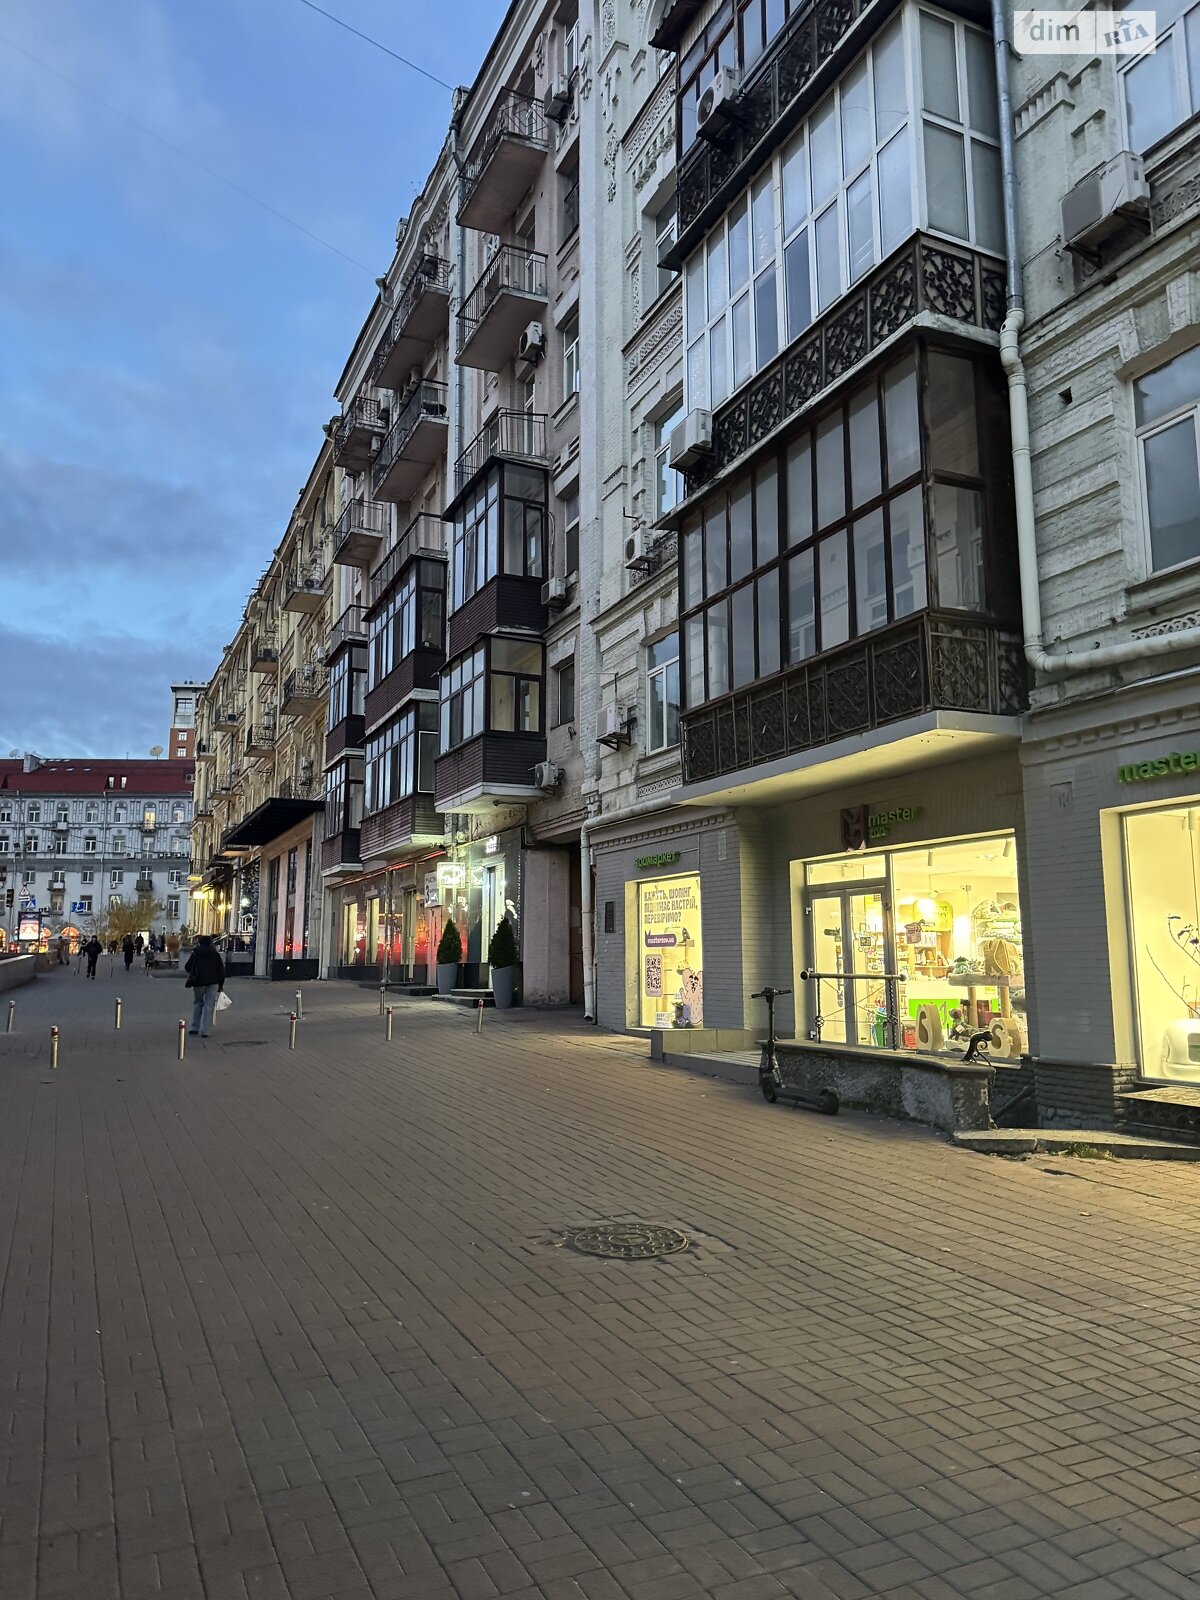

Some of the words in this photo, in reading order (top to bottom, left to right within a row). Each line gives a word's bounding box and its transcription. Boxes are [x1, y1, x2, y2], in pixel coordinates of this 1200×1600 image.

[868, 807, 918, 827] master
[634, 851, 677, 868] зоомаркет
[668, 886, 692, 899] ШОПІНГ
[671, 896, 698, 911] НАСТРІЙ,
[644, 912, 682, 924] ПЕРЕВІРИМО?
